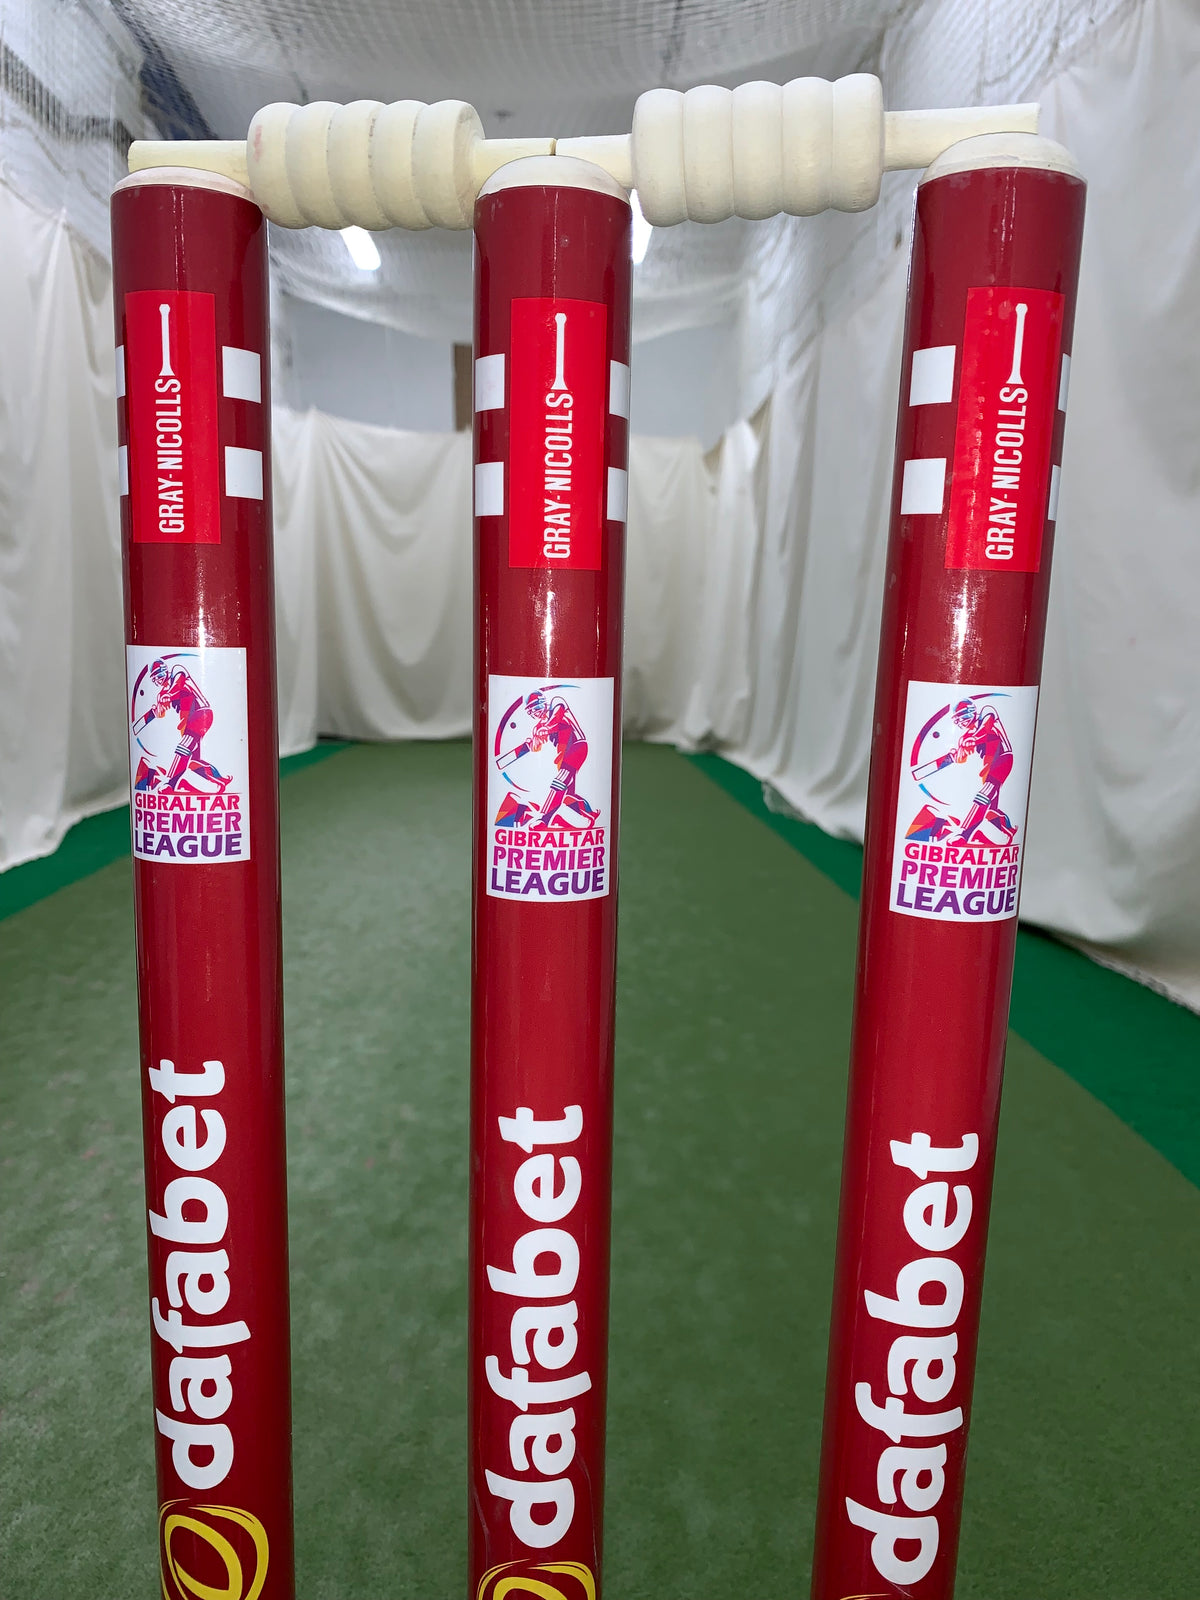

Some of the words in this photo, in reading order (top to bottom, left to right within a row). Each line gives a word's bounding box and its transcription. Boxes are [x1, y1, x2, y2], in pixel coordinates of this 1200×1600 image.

[155, 378, 185, 533] GRAY-NICOLLS
[543, 392, 574, 559] GRAY-NICOLLS
[985, 386, 1028, 560] GRAY-NICOLLS
[135, 792, 240, 812] GIBRALTAR
[135, 809, 242, 834] PREMIER
[135, 828, 242, 858] LEAGUE
[494, 828, 605, 848] GIBRALTAR
[493, 845, 605, 871] PREMIER
[904, 842, 1020, 865] GIBRALTAR
[491, 867, 605, 895] LEAGUE
[900, 860, 1018, 889] PREMIER
[896, 882, 1016, 915] LEAGUE
[148, 1059, 251, 1490] dafabet
[485, 1104, 592, 1549] dafabet
[845, 1132, 979, 1586] dafabet
